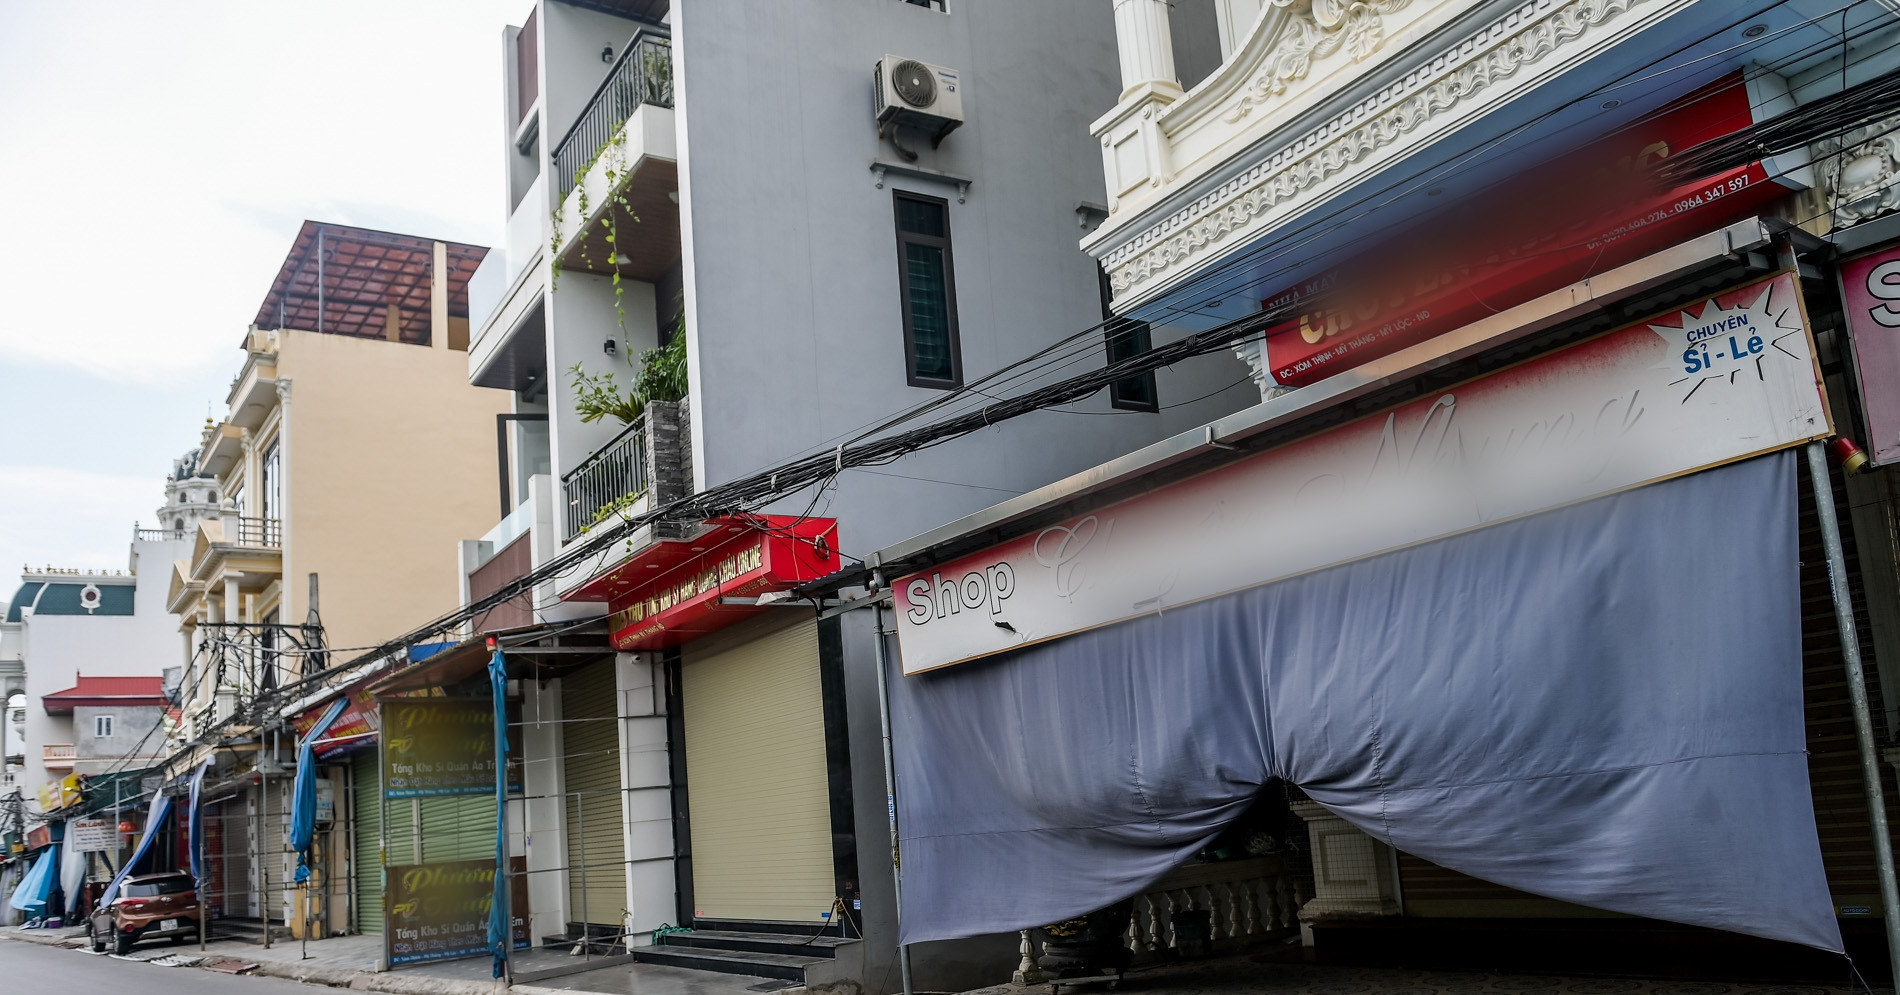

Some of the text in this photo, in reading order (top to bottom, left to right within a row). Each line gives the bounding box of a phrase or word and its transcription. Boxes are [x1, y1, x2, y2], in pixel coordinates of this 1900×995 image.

[1647, 210, 1667, 224] 276
[1674, 194, 1703, 213] 0964
[1705, 184, 1726, 202] 347
[1728, 174, 1750, 192] 597
[1682, 342, 1711, 374] Sỉ
[1728, 326, 1764, 360] Lẻ
[1686, 313, 1749, 343] CHUYÊN
[1293, 359, 1313, 374] XÓM
[1311, 351, 1333, 366] THỊNH
[1336, 343, 1348, 356] MỸ
[906, 561, 1016, 626] Shop
